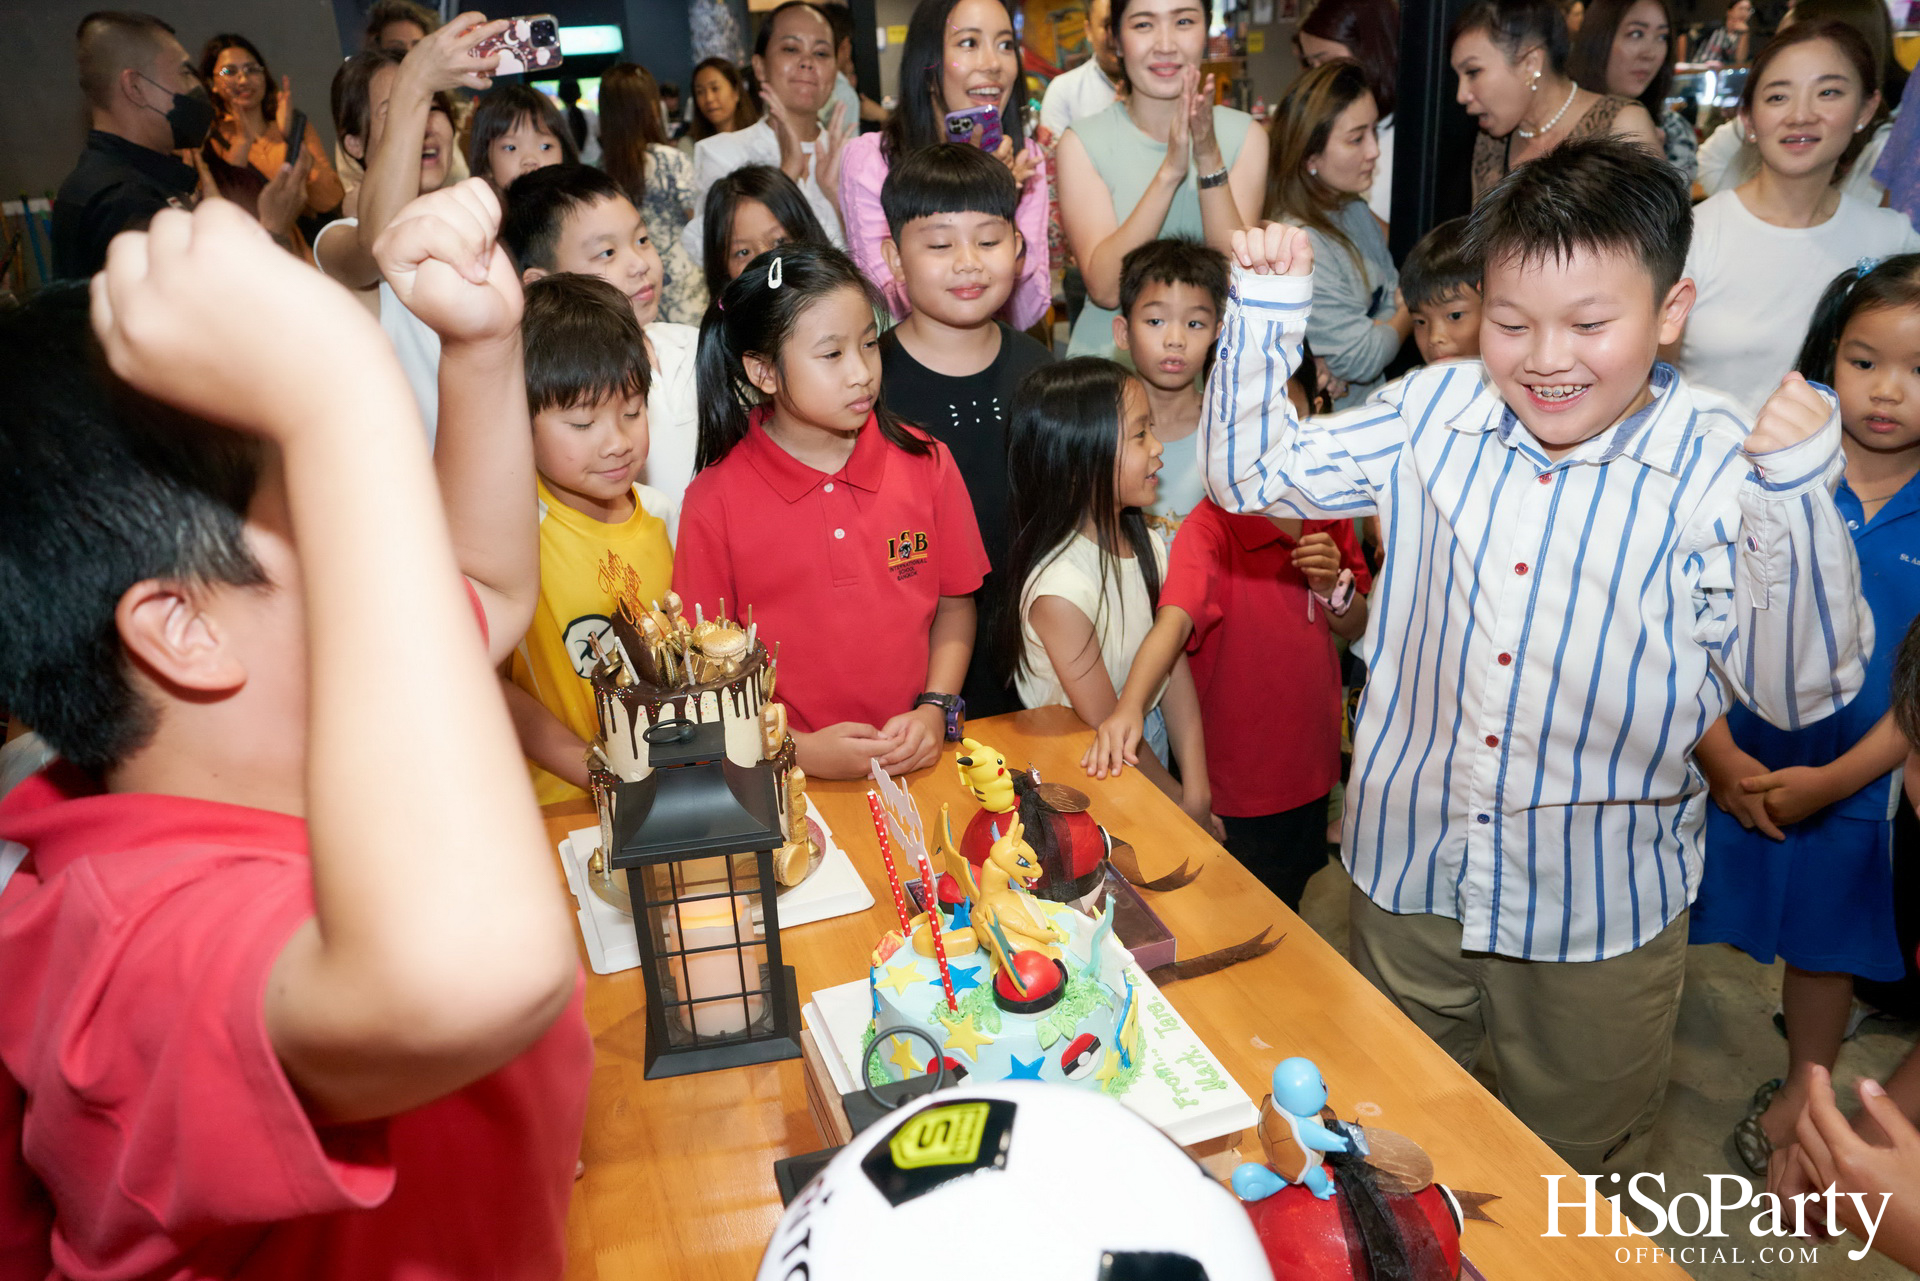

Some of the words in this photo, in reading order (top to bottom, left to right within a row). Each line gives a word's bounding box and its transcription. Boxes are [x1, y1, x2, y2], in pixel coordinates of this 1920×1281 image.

[888, 559, 928, 572] INTERNATIONAL
[897, 571, 918, 581] BANGKOK
[898, 566, 915, 576] SCHOOL
